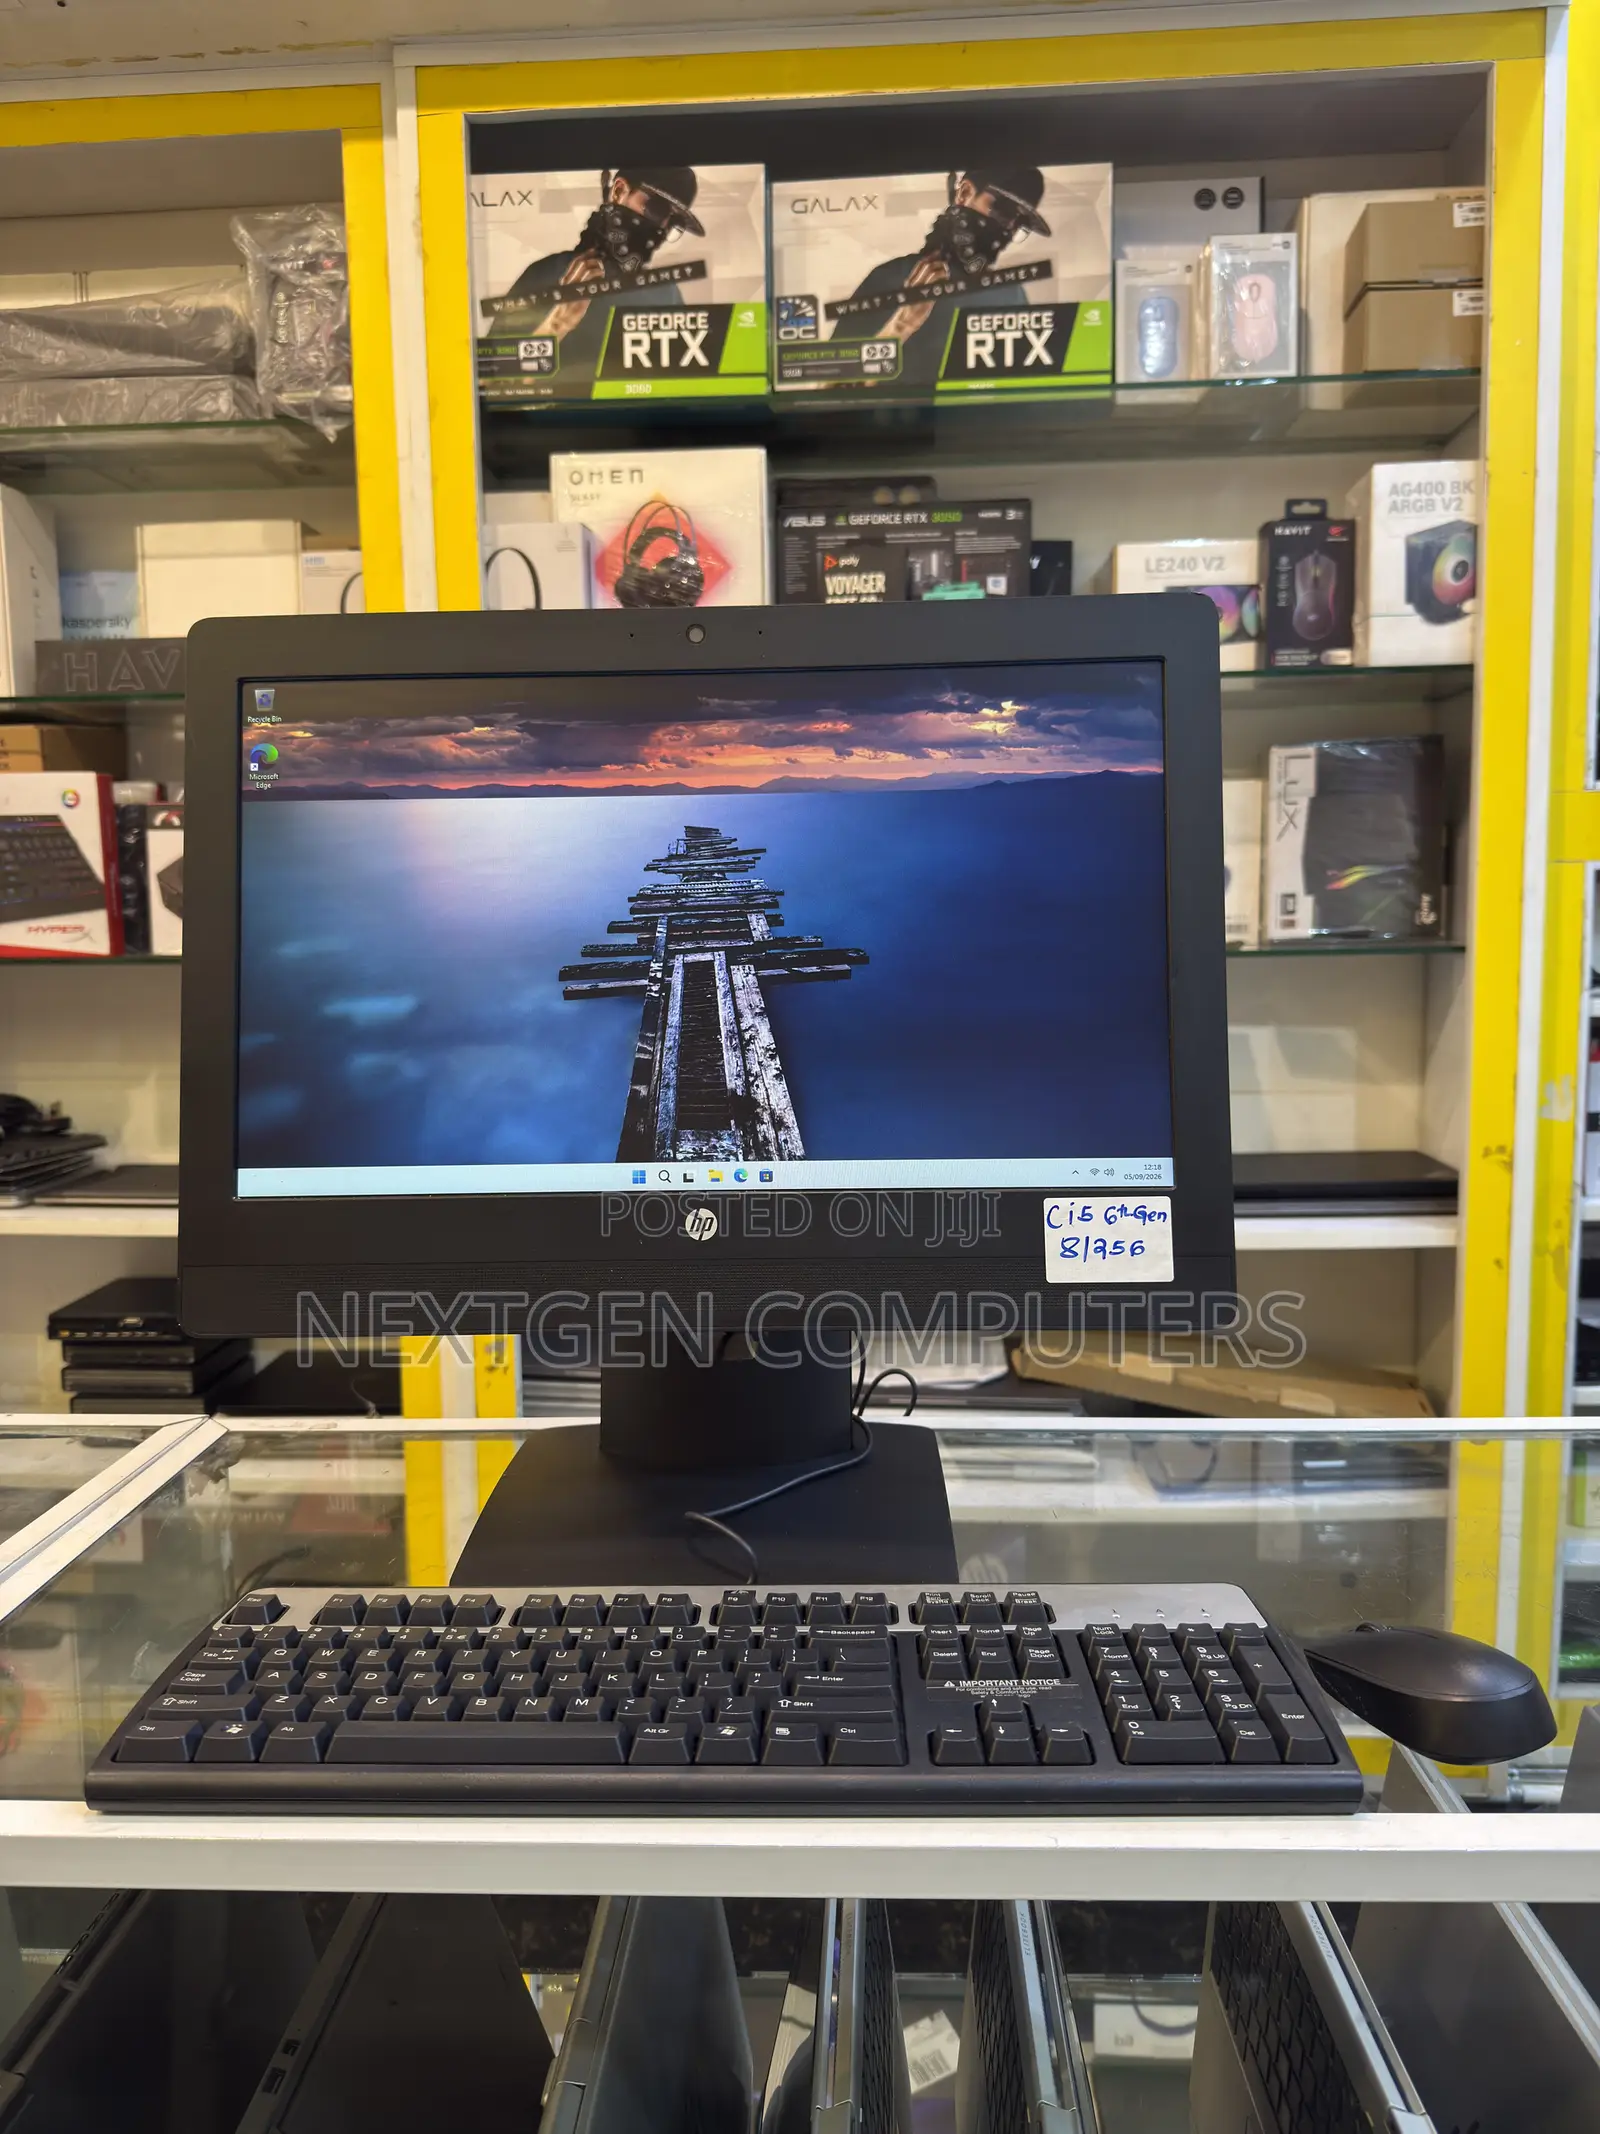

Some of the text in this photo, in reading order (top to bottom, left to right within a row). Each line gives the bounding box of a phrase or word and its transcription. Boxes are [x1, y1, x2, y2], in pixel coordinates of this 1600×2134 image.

[790, 193, 880, 215] GALAX
[492, 265, 694, 313] WHAT'S YOUR GAME?
[836, 266, 1040, 315] WHAT'S YOUR GAME?
[622, 311, 709, 332] GEFORCE
[966, 311, 1054, 332] GEFORCE
[779, 326, 816, 340] OC
[622, 330, 709, 369] RTX
[966, 329, 1054, 369] RTX
[569, 469, 644, 485] OMEN
[1388, 479, 1475, 498] AG400 BK
[1388, 496, 1465, 515] ARGB V2
[783, 515, 826, 528] ASUS
[848, 511, 902, 526] GEFORCE
[903, 511, 928, 524] RTX
[838, 554, 860, 568] poly
[1145, 556, 1226, 573] LE240 V2
[824, 572, 886, 596] VOYAGER
[64, 648, 181, 693] HAV
[256, 782, 272, 790] Edge
[1143, 1163, 1162, 1171] 12:18
[1123, 1173, 1163, 1181] 05/09/2026
[686, 1208, 718, 1241] hp
[510, 1650, 521, 1658] Y
[268, 1671, 280, 1679] A
[462, 1673, 475, 1681] G
[324, 1696, 338, 1704] X
[427, 1697, 438, 1705] V
[525, 1698, 538, 1706] N
[575, 1698, 589, 1706] M
[1128, 1721, 1139, 1729] 0
